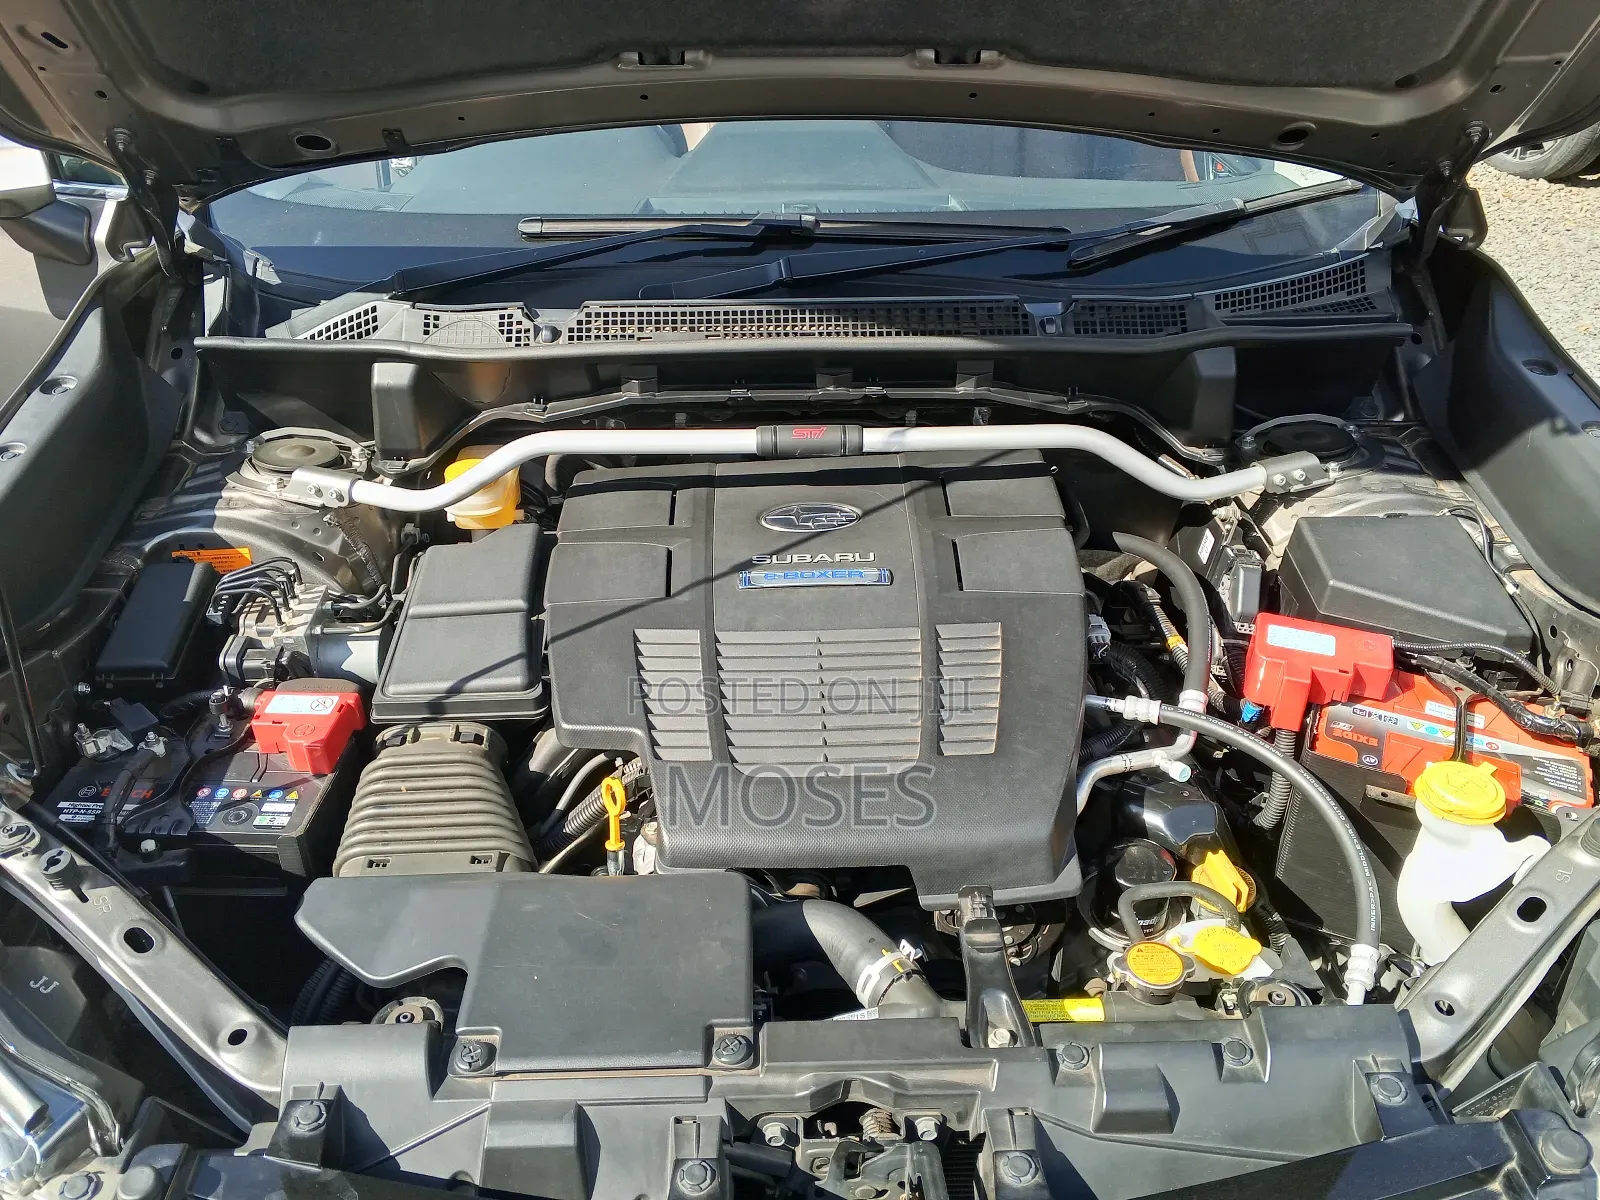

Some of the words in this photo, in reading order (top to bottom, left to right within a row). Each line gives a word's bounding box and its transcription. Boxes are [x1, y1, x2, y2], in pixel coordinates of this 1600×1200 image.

[751, 551, 876, 565] SUBARU
[763, 568, 865, 581] e-BOXER
[1332, 728, 1379, 747] EXIDE
[93, 895, 112, 915] SR
